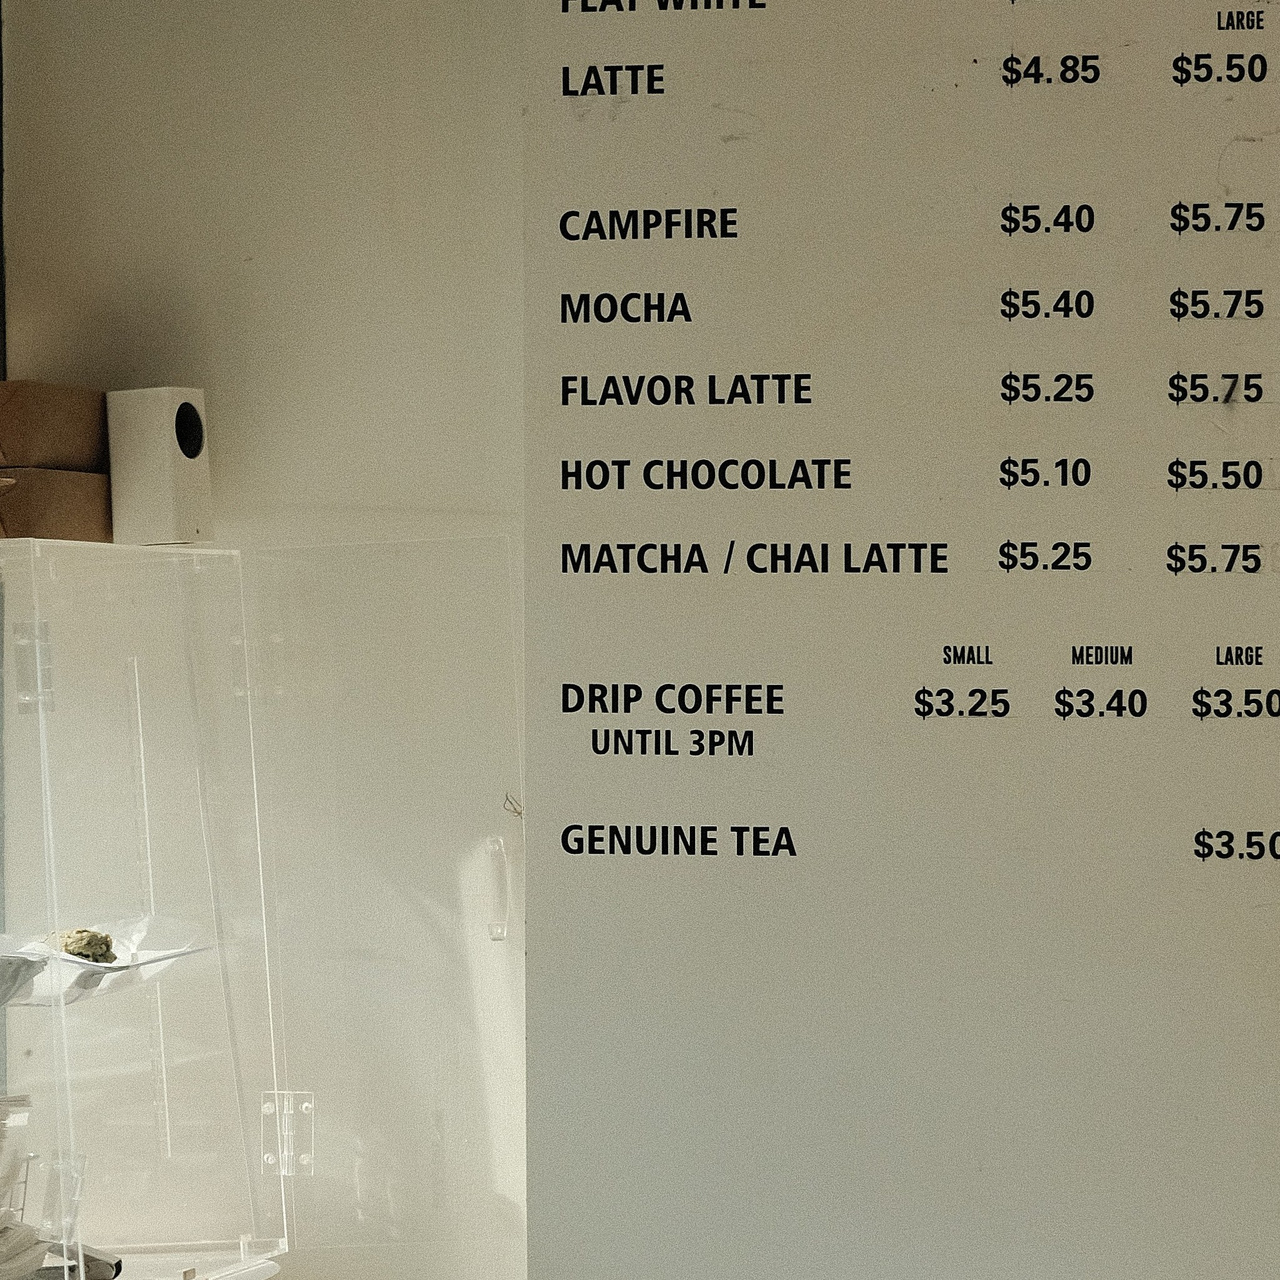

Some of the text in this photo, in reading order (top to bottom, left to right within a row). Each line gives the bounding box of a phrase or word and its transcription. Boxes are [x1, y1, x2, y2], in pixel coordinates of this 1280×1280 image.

[1218, 11, 1263, 30] LARGE
[563, 54, 1267, 96] LATTE $4.85 $5.50
[560, 202, 1264, 240] CAMPFIRE $5.40 $5.75
[562, 288, 1263, 323] MOCHA $5.40 $5.75
[562, 372, 1262, 405] FLAVOR LATTE $5.25 $5.75
[562, 457, 1262, 491] HOT CHOCOLATE $5.10 $5.50
[562, 541, 1261, 574] MATCHA / CHAI LATTE $5.25 $5.75
[944, 646, 1262, 665] SMALL MEDIUM LARGE
[563, 684, 642, 713] DRIP
[656, 684, 783, 714] COFFEE
[915, 688, 1009, 718] $3.25
[1055, 688, 1147, 719] $3.40
[592, 730, 753, 755] UNTIL 3PM
[562, 825, 717, 855] GENUINE
[731, 827, 796, 856] TEA
